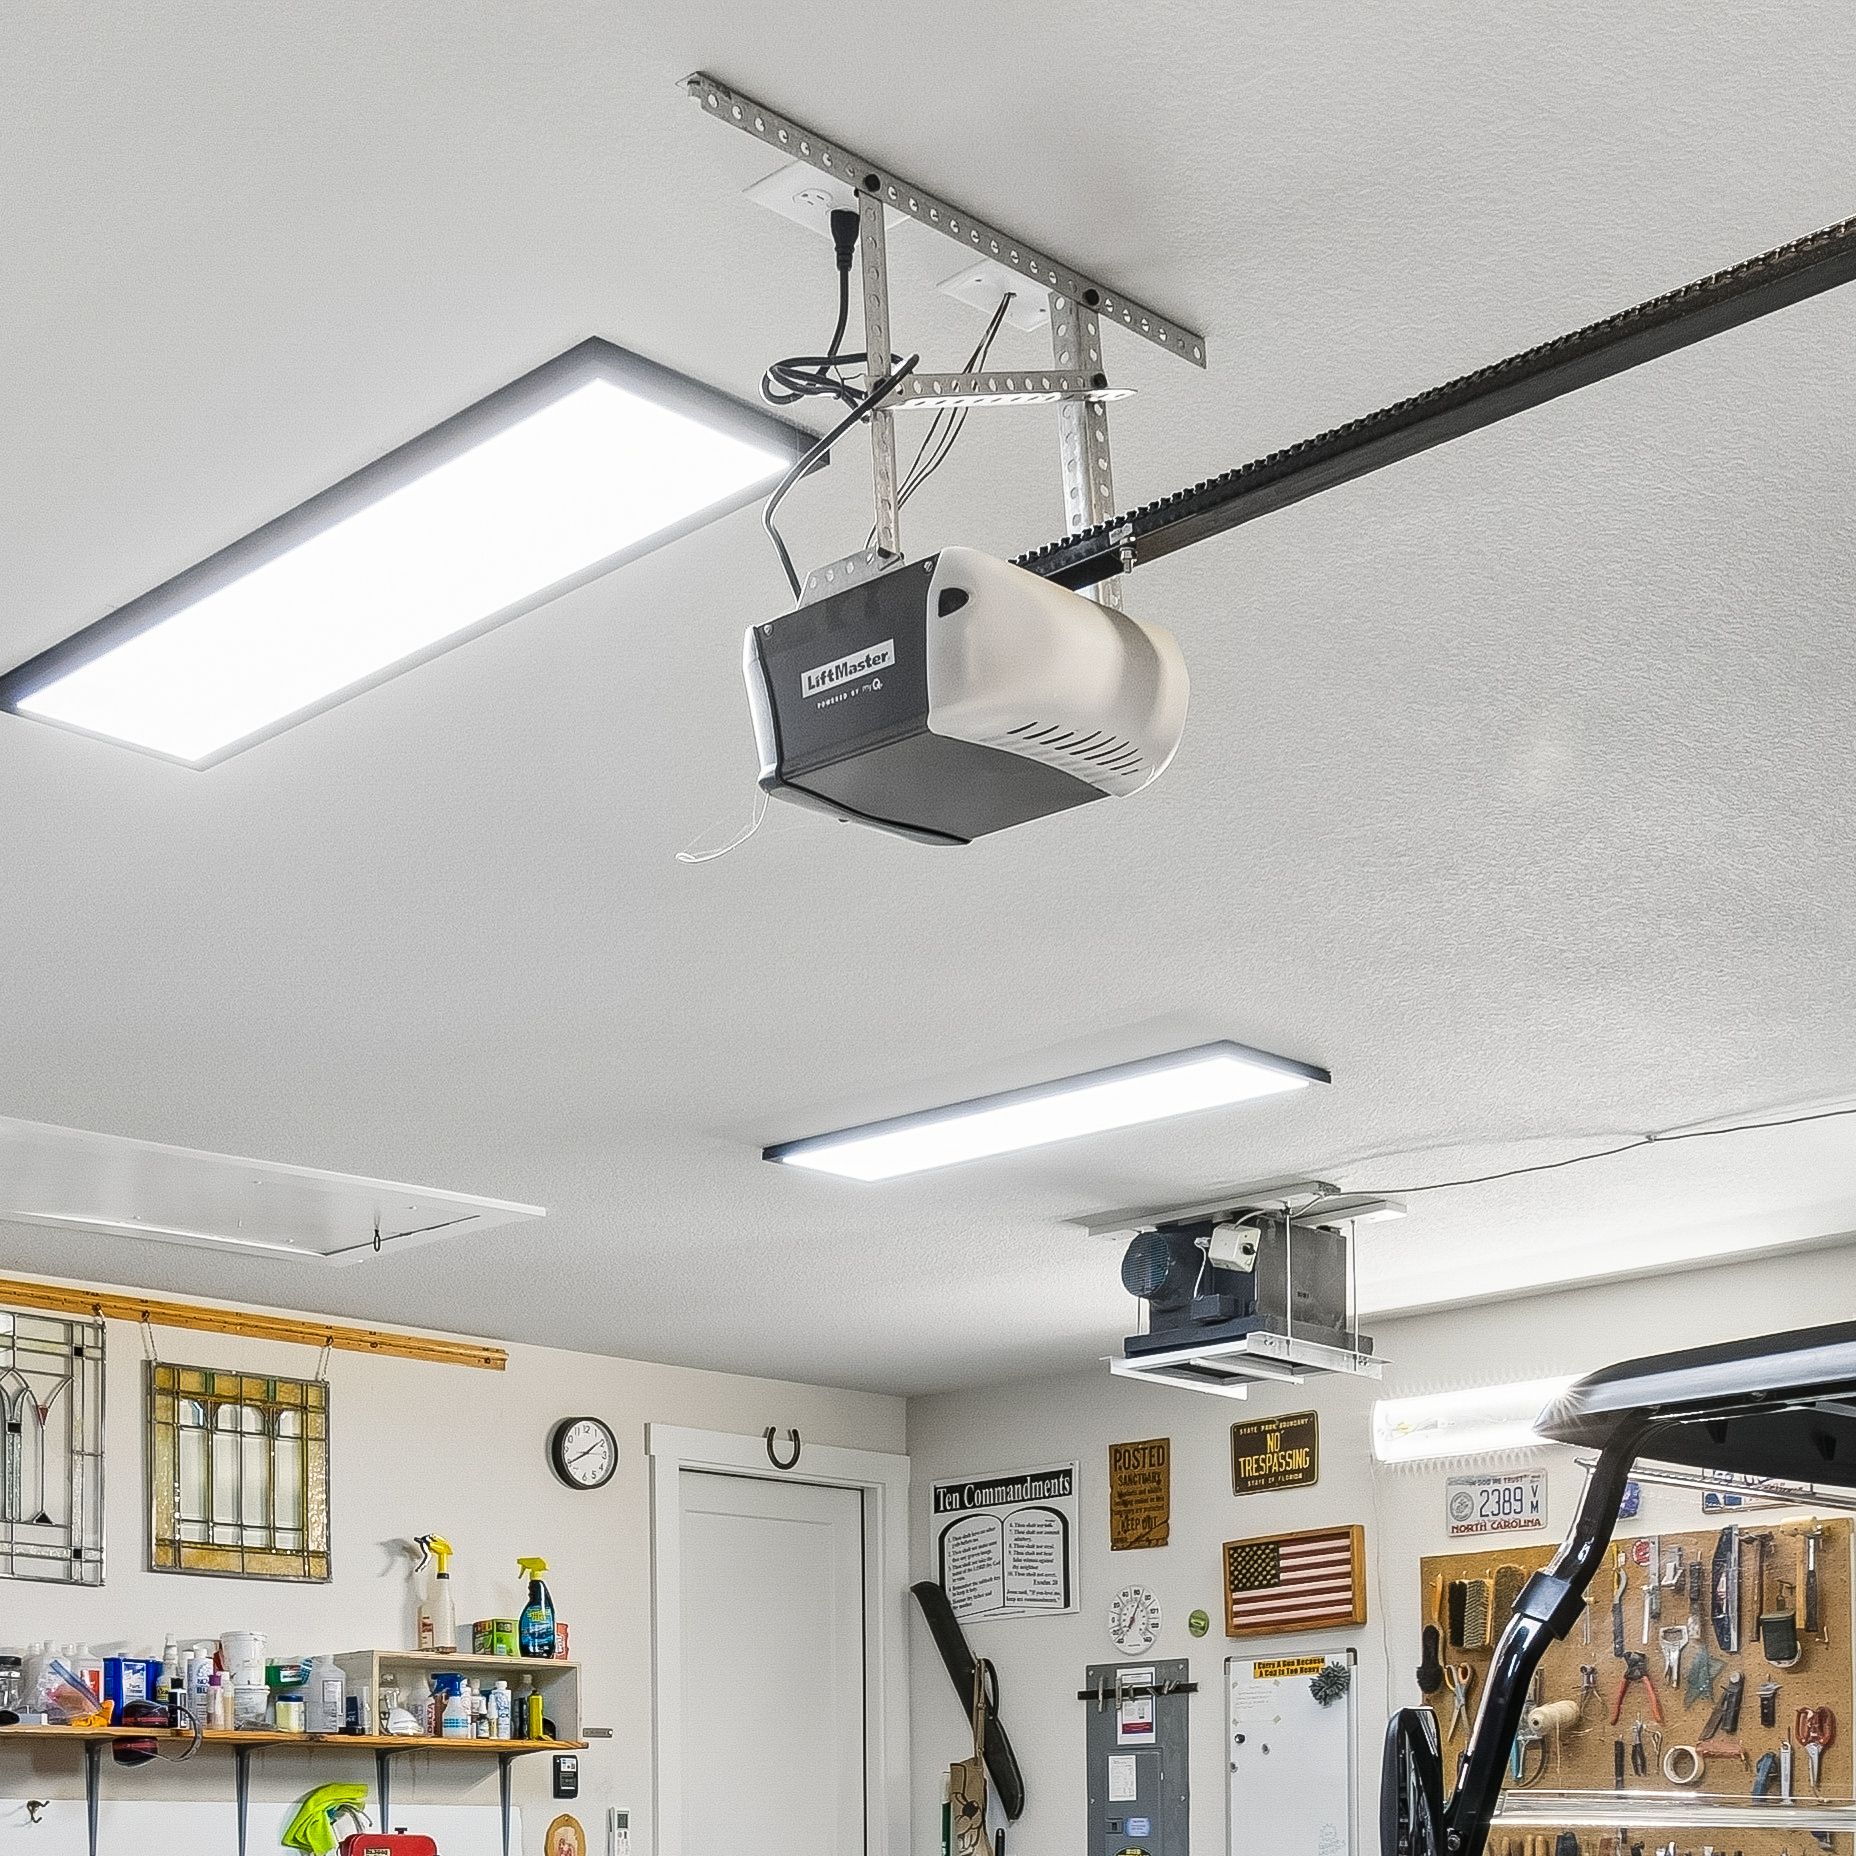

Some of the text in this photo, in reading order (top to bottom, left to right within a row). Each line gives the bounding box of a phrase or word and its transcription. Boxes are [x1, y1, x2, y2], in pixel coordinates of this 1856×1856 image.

[807, 651, 889, 691] LiftMaster
[1266, 1432, 1280, 1453] NO
[1113, 1445, 1165, 1472] POSTED
[1238, 1447, 1310, 1478] TRESPASSING
[936, 1473, 1071, 1511] Ten Commandments
[1479, 1486, 1524, 1517] 2389
[1531, 1484, 1538, 1498] V
[1530, 1500, 1539, 1514] M
[1451, 1518, 1542, 1534] NORTH CAROLINA
